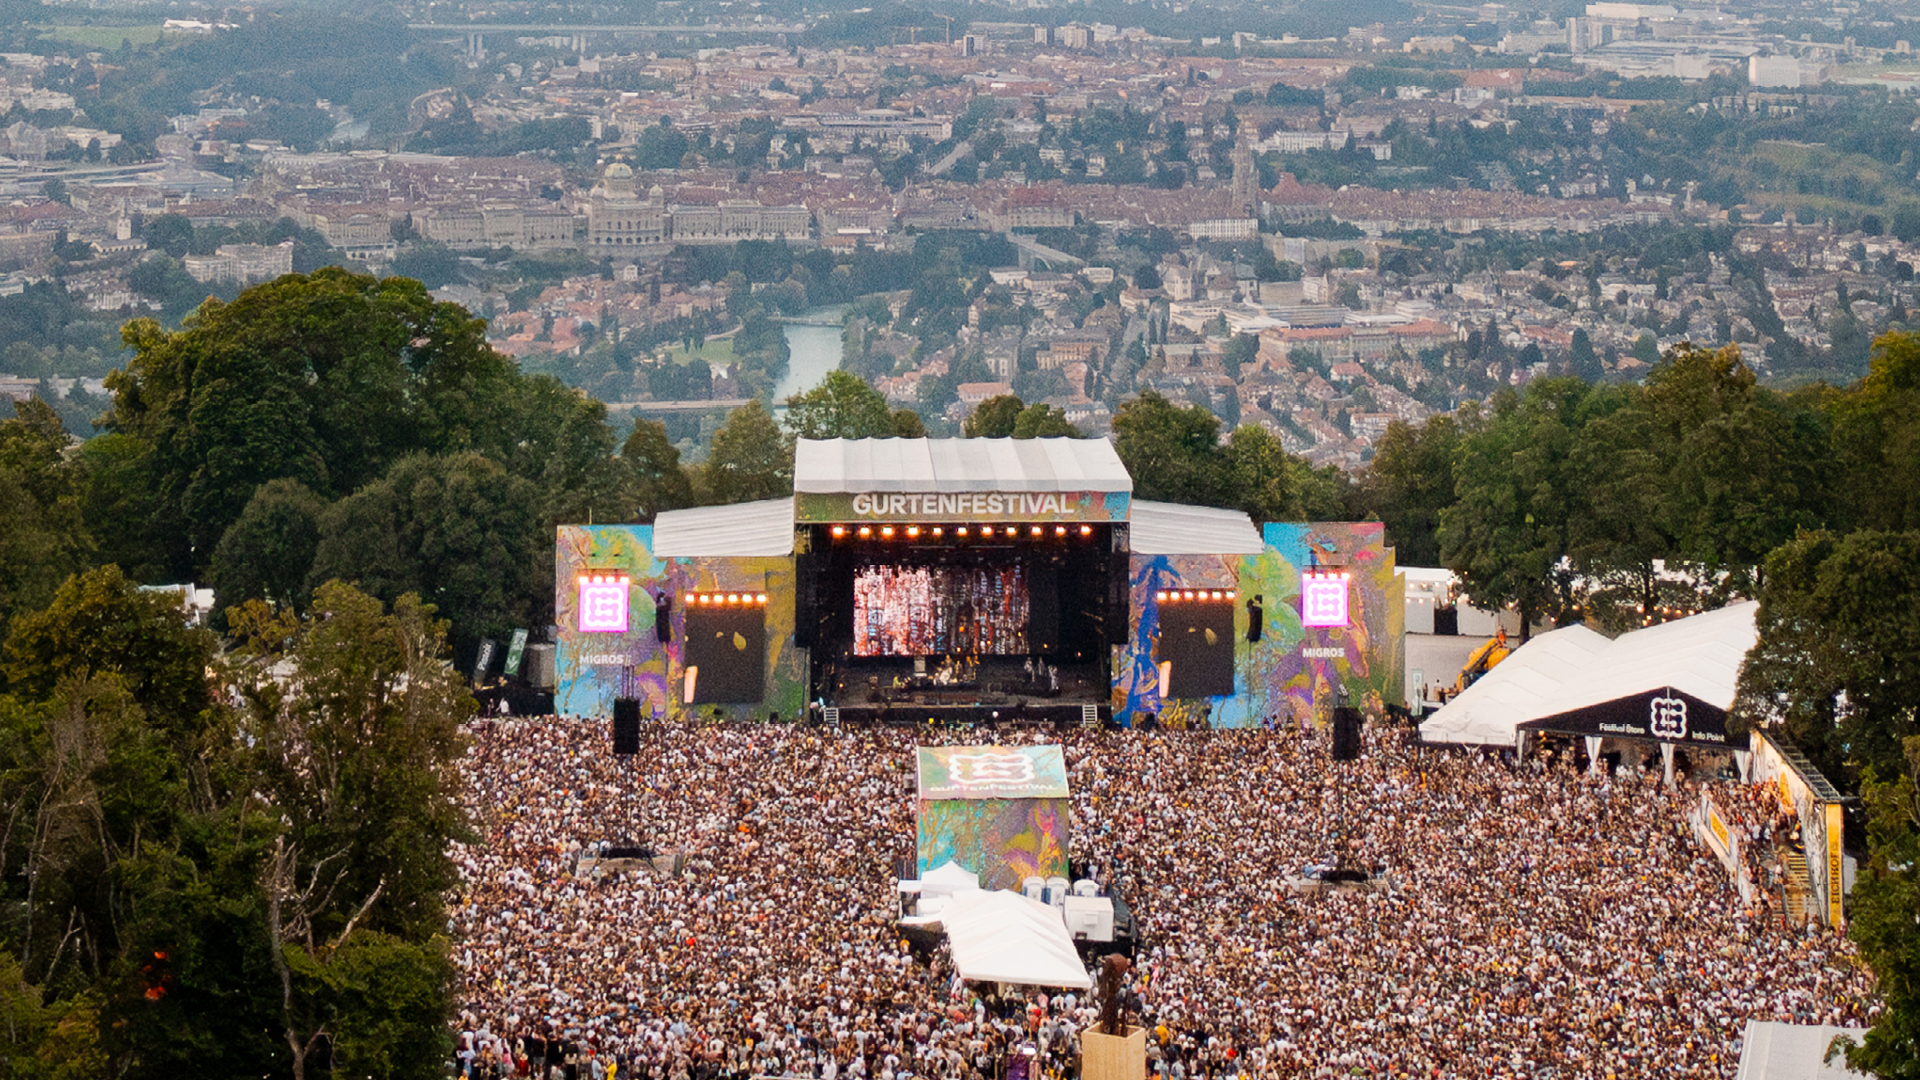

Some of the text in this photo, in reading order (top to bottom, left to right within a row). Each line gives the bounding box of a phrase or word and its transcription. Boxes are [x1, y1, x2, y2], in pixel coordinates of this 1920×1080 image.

[852, 493, 1075, 515] GURTENFESTIVAL
[1302, 647, 1345, 658] MIGROS
[579, 654, 624, 665] MIGROS
[1692, 731, 1725, 742] Info Point
[1830, 852, 1840, 905] EICHHOF
